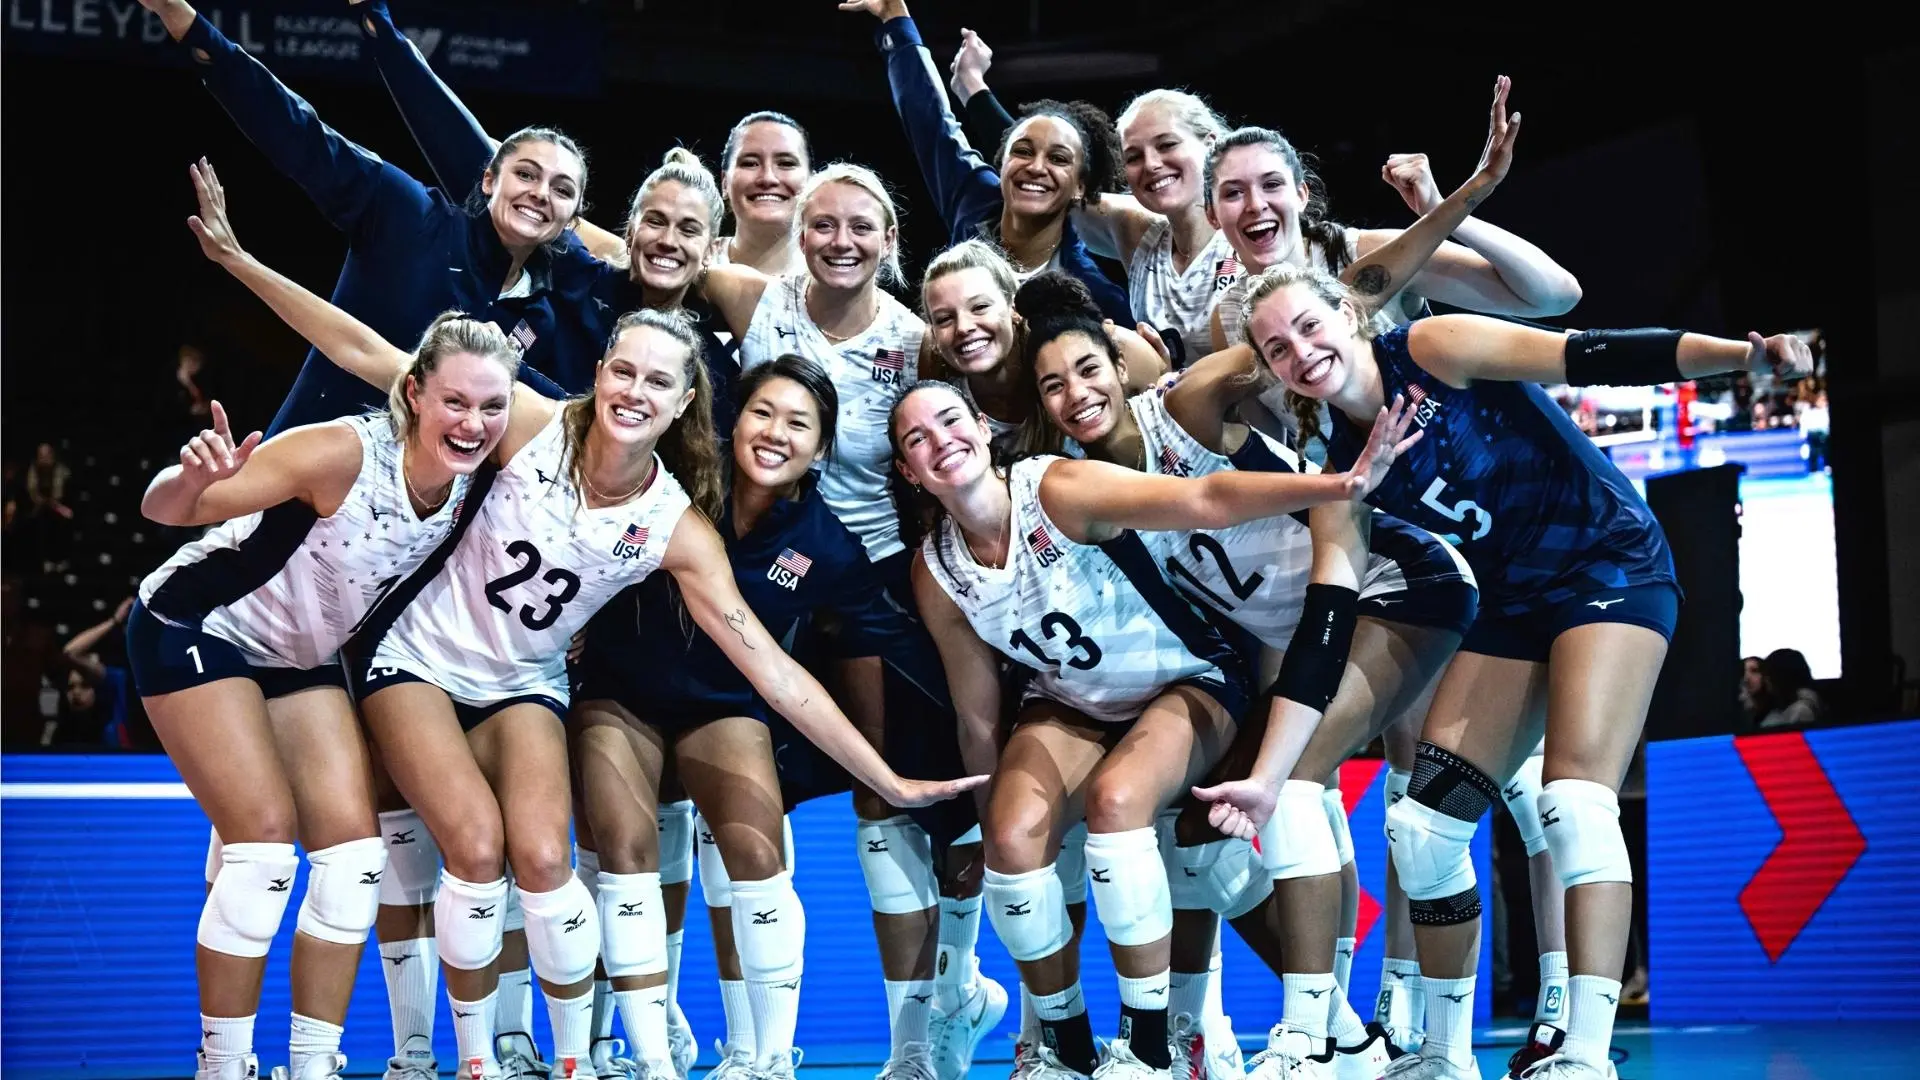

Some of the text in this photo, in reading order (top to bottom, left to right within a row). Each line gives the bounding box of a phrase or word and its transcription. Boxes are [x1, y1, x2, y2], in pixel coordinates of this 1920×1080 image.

[9, 0, 265, 54] LLEYBL
[871, 366, 903, 388] USA
[1413, 396, 1443, 429] USA
[613, 540, 642, 560] USA
[1036, 548, 1065, 569] USA
[484, 540, 582, 631] 23
[767, 563, 800, 591] USA
[1166, 533, 1265, 612] 12
[186, 645, 204, 674] 1
[1009, 611, 1102, 679] 13
